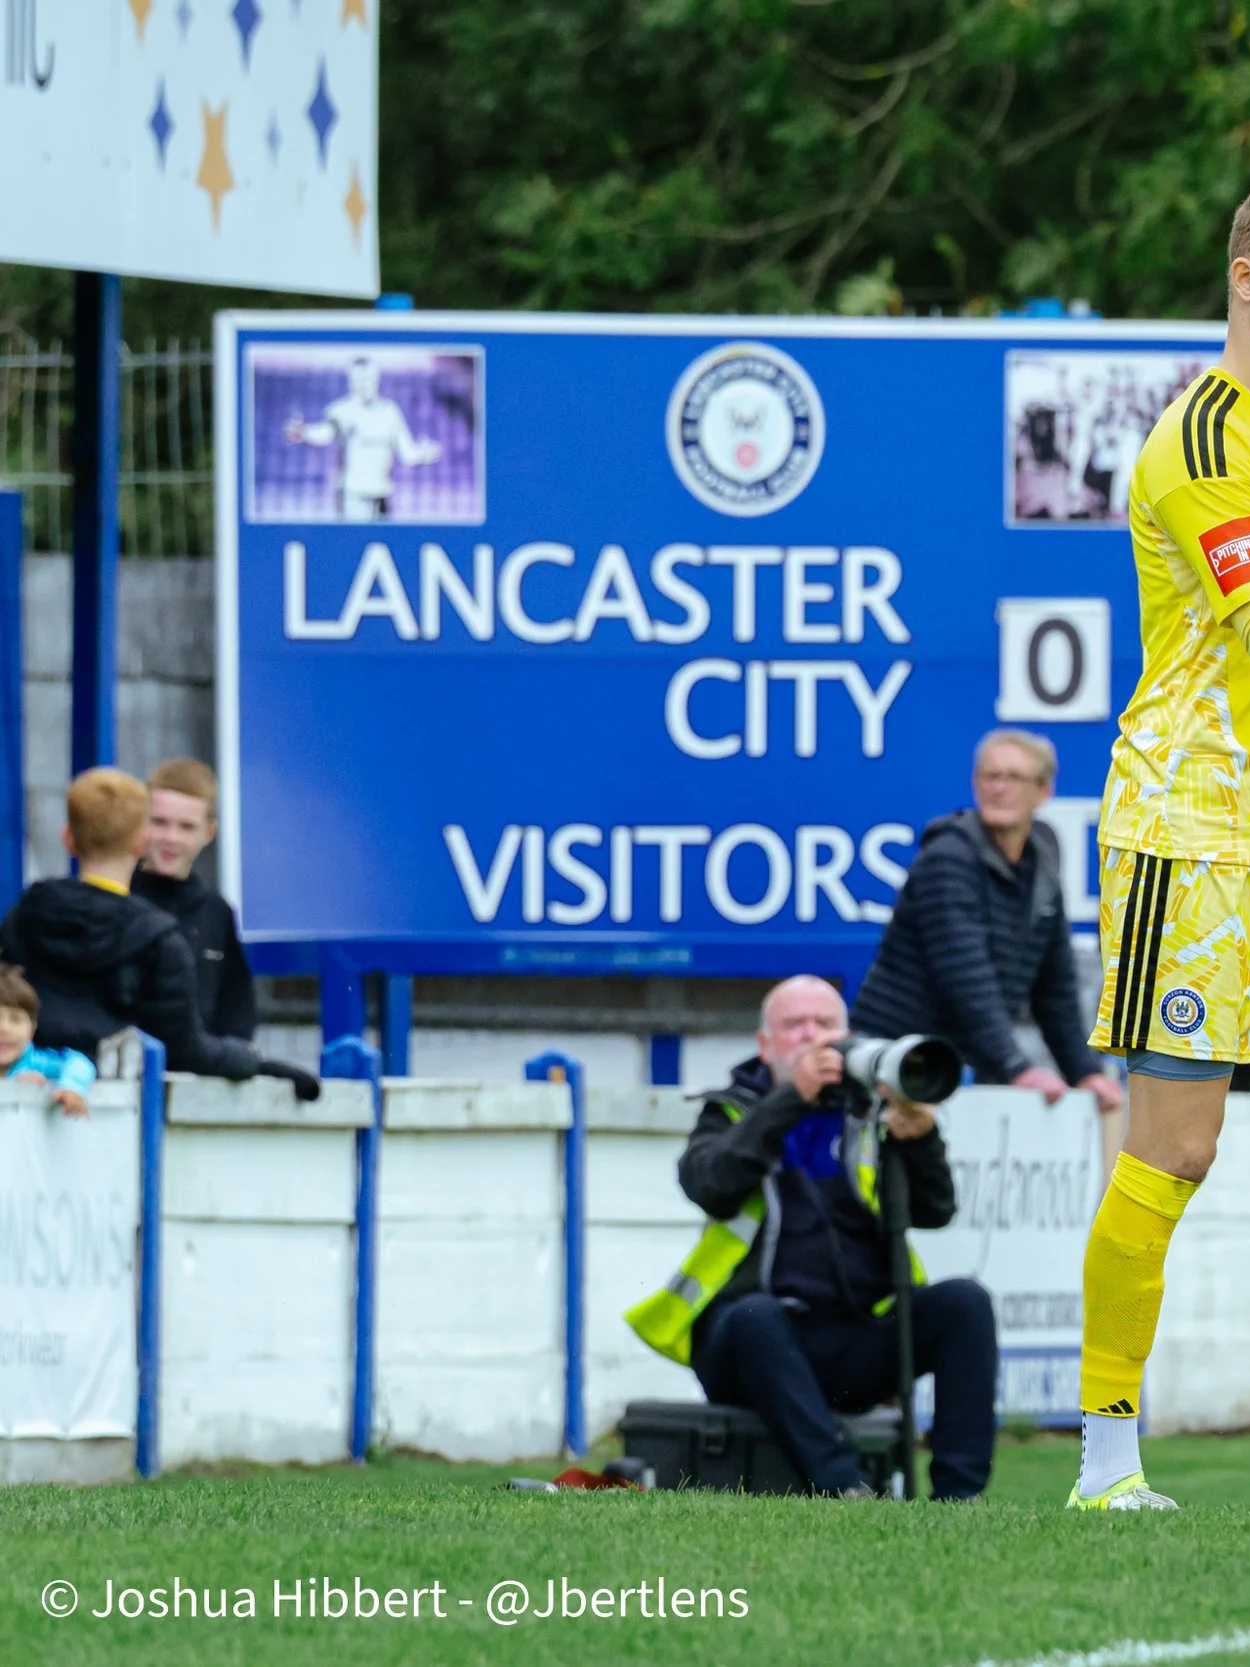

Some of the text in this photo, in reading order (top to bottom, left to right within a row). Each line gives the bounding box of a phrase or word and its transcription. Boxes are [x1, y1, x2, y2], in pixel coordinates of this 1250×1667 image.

[283, 541, 911, 645] LANCASTER
[1239, 549, 1250, 562] IN
[665, 658, 912, 760] CITY
[1027, 617, 1085, 707] 0
[444, 823, 913, 925] VISITORS
